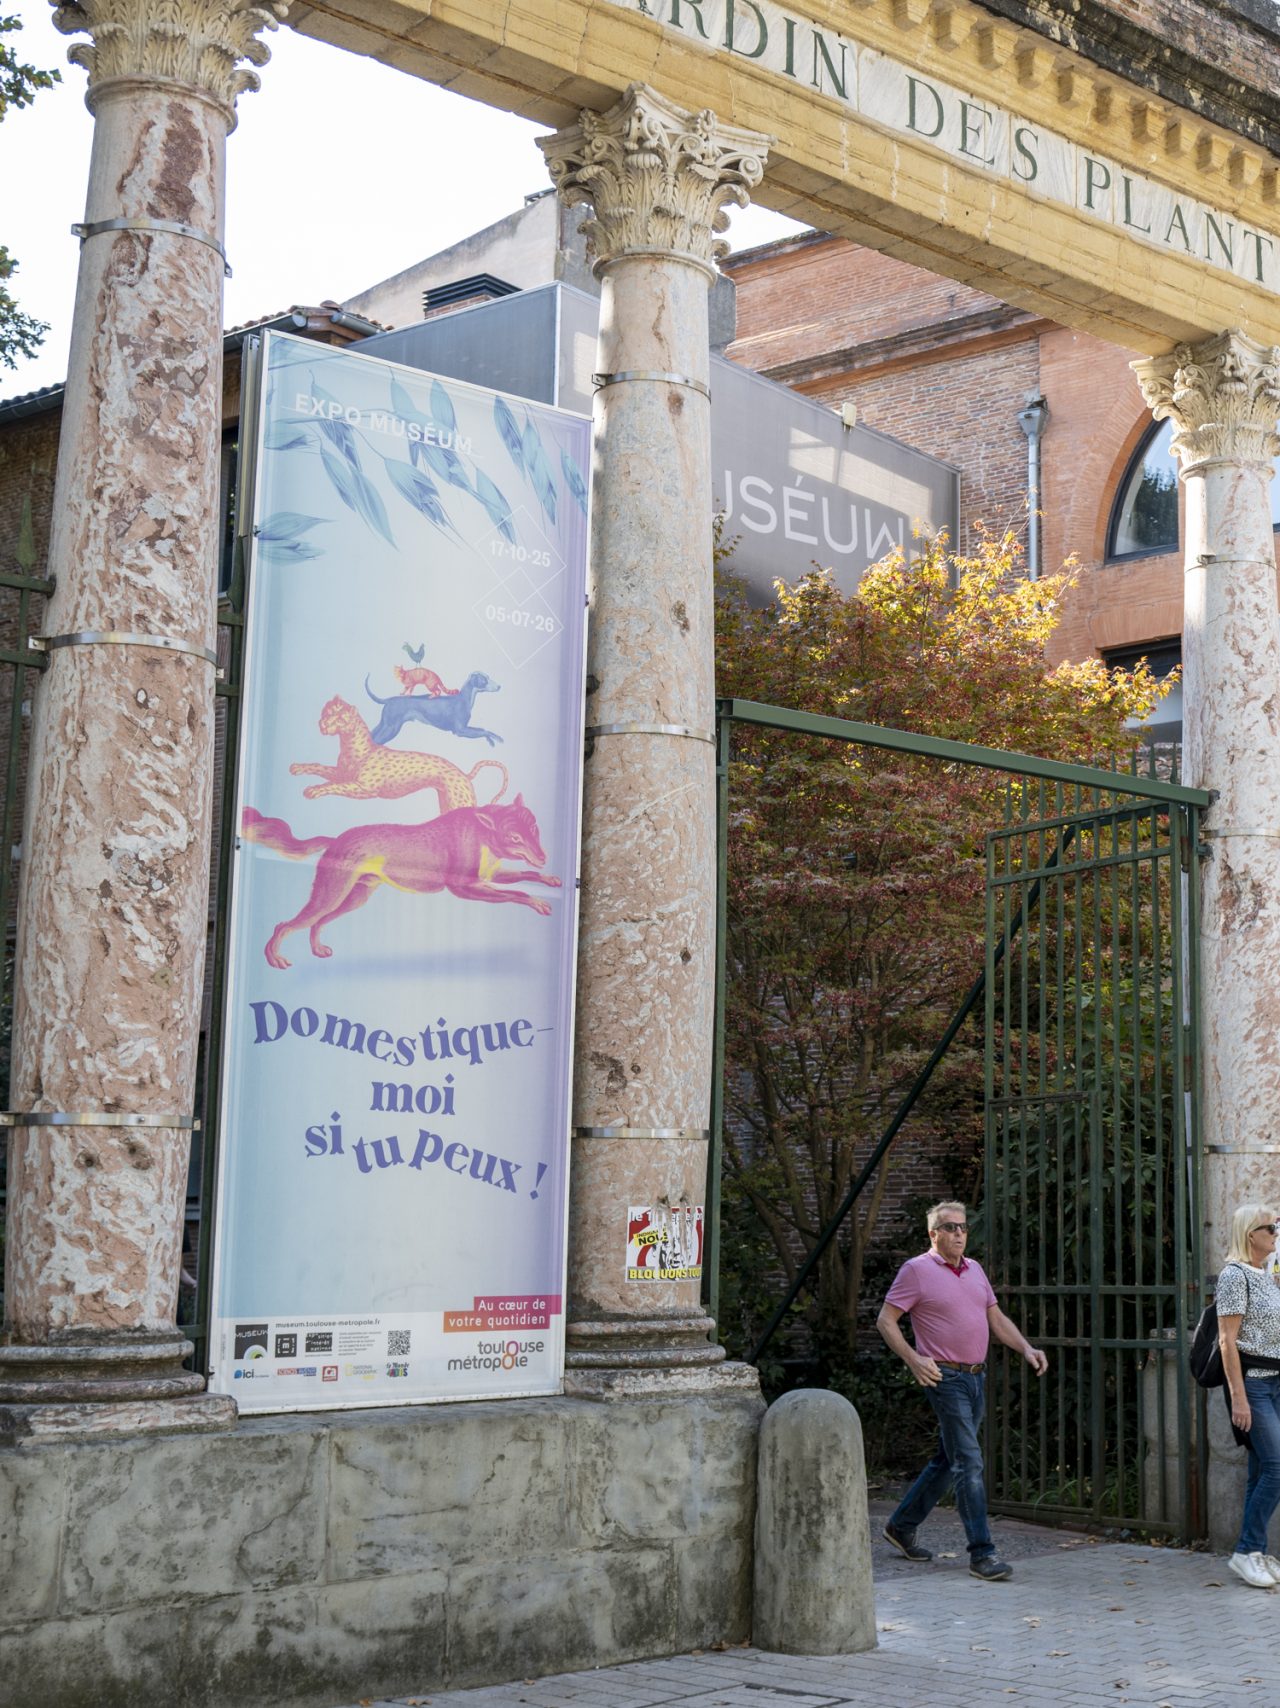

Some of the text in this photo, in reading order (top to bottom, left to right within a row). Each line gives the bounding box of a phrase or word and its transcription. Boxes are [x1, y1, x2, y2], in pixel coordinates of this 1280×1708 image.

[638, 0, 849, 100] RDIN
[904, 74, 1039, 182] DES
[295, 393, 473, 454] EXPO MUSÉUM
[369, 1073, 456, 1116] moi
[304, 1111, 345, 1158] si
[352, 1135, 405, 1173] tu
[408, 1128, 522, 1194] peux
[448, 1313, 546, 1329] votre quotidien
[478, 1298, 546, 1311] Au cœur de
[242, 1369, 255, 1379] ici
